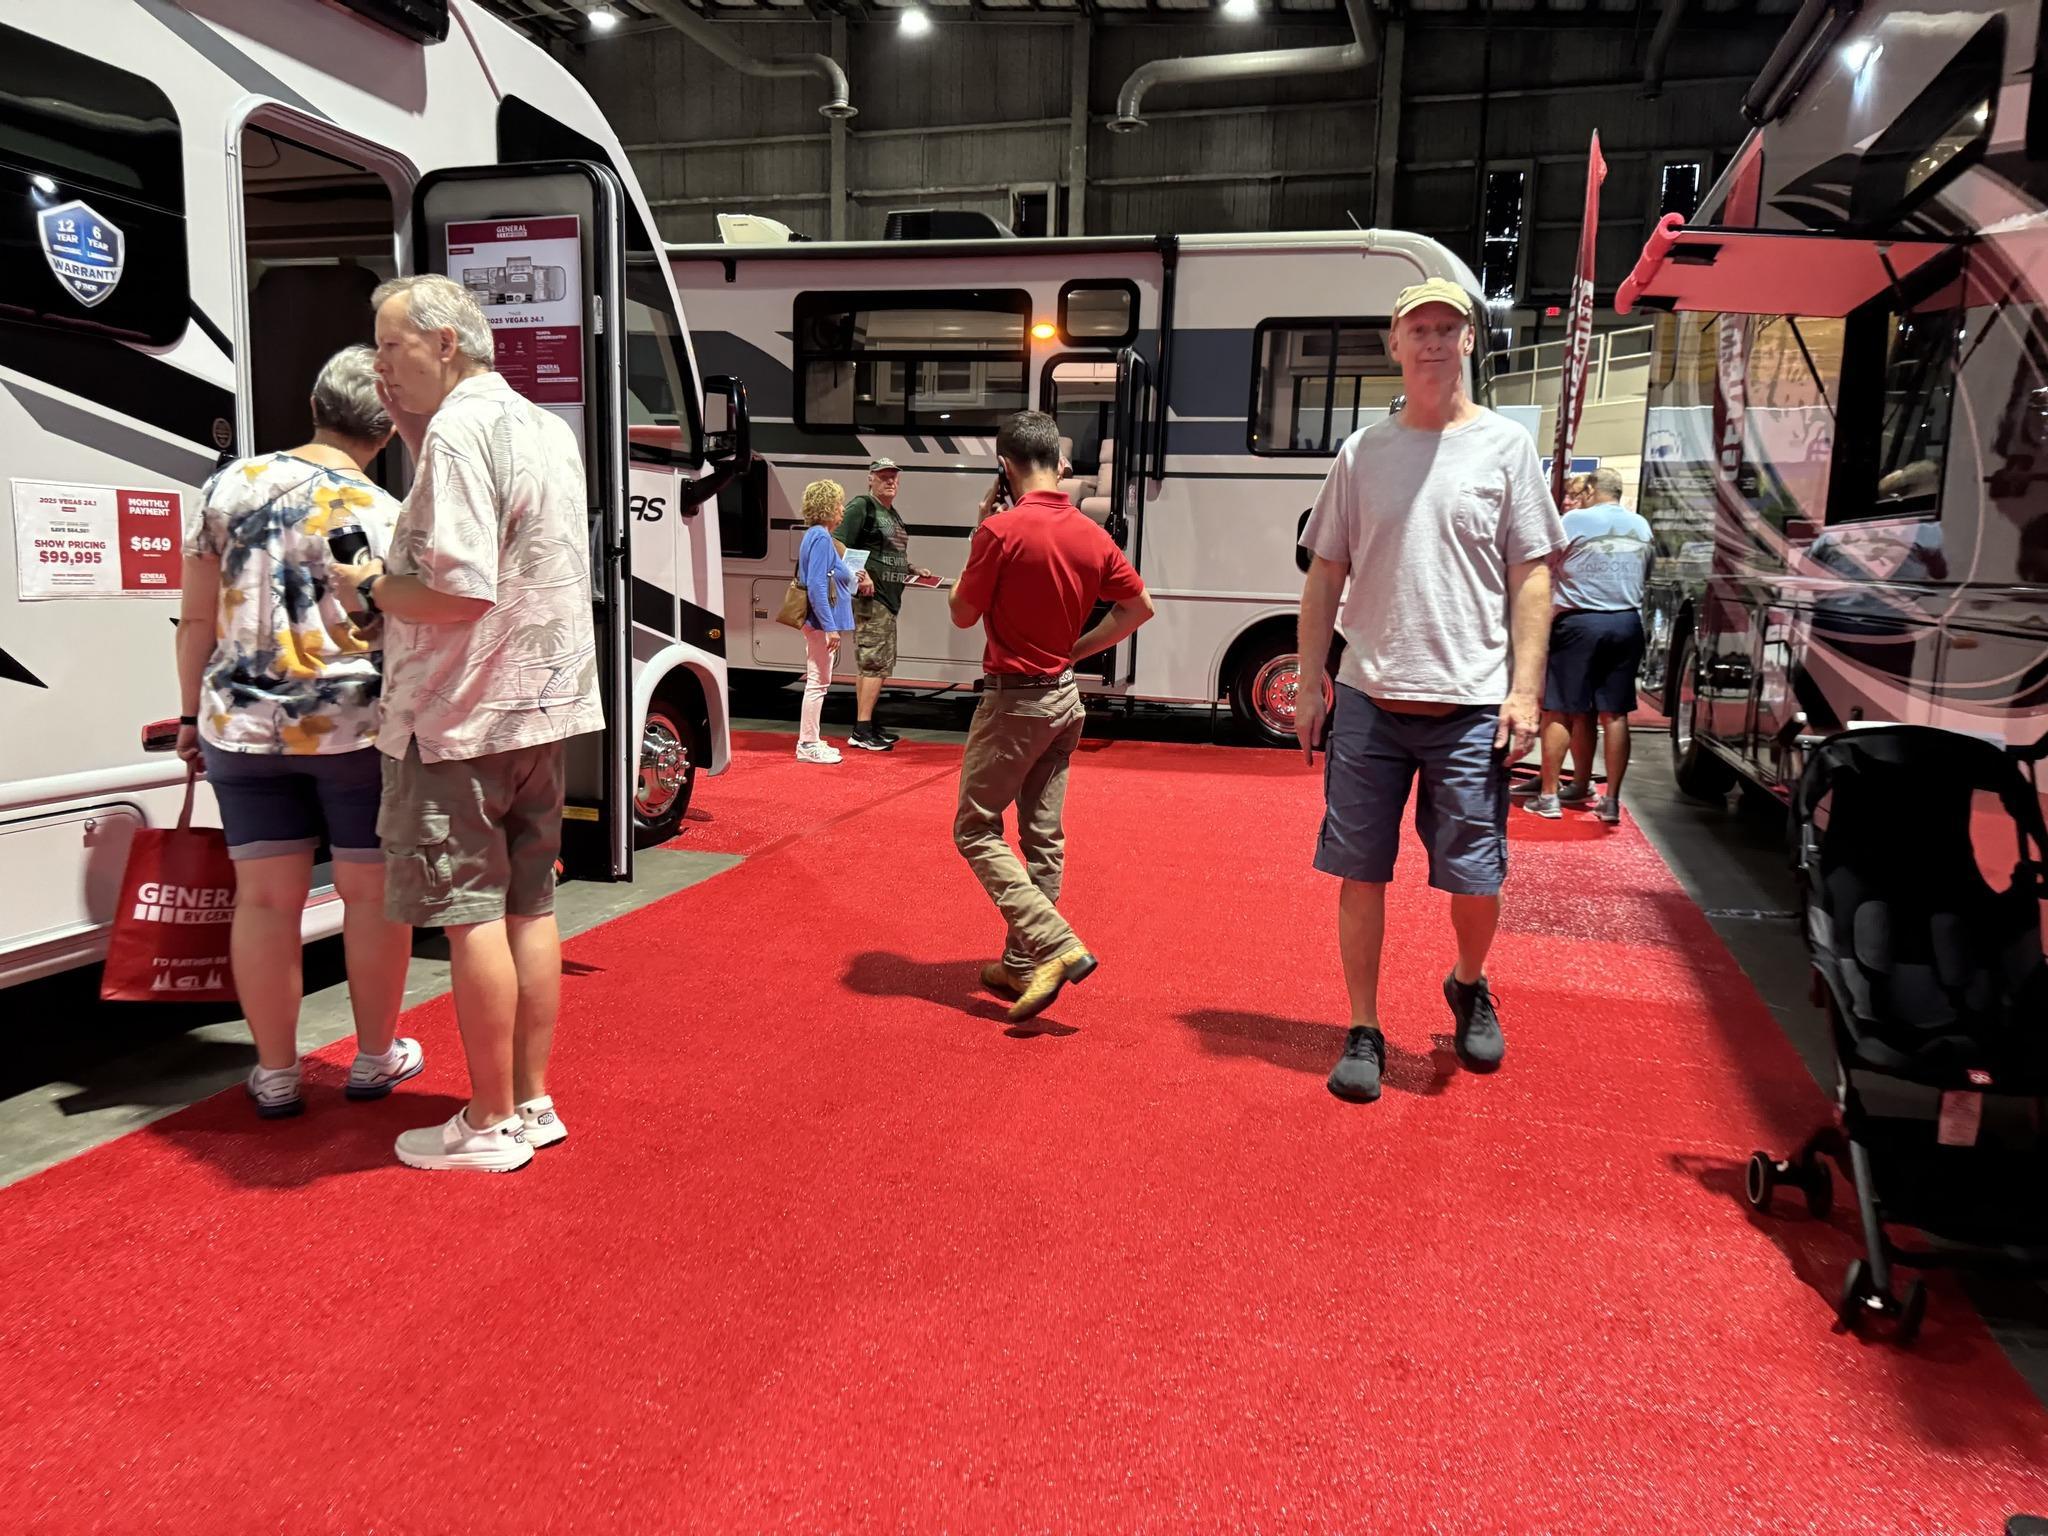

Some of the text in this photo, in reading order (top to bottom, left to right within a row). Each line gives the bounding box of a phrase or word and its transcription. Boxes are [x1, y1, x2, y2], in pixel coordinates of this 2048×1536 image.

[58, 219, 75, 232] 12
[496, 225, 527, 233] GENERAL
[56, 232, 79, 243] YEAR
[92, 225, 102, 239] 6
[87, 237, 109, 251] YEAR
[52, 257, 117, 280] WARRANTY
[505, 316, 529, 324] VEGAS
[58, 498, 82, 506] VEGAS
[128, 498, 170, 508] MONTHLY
[129, 507, 170, 516] PAYMENT
[630, 495, 666, 522] AS
[34, 539, 106, 550] SHOW PRICING
[130, 536, 171, 552] $649
[39, 550, 102, 565] $99,995
[138, 882, 237, 907] GENER
[205, 911, 234, 922] CENT
[170, 957, 213, 967] RATHER
